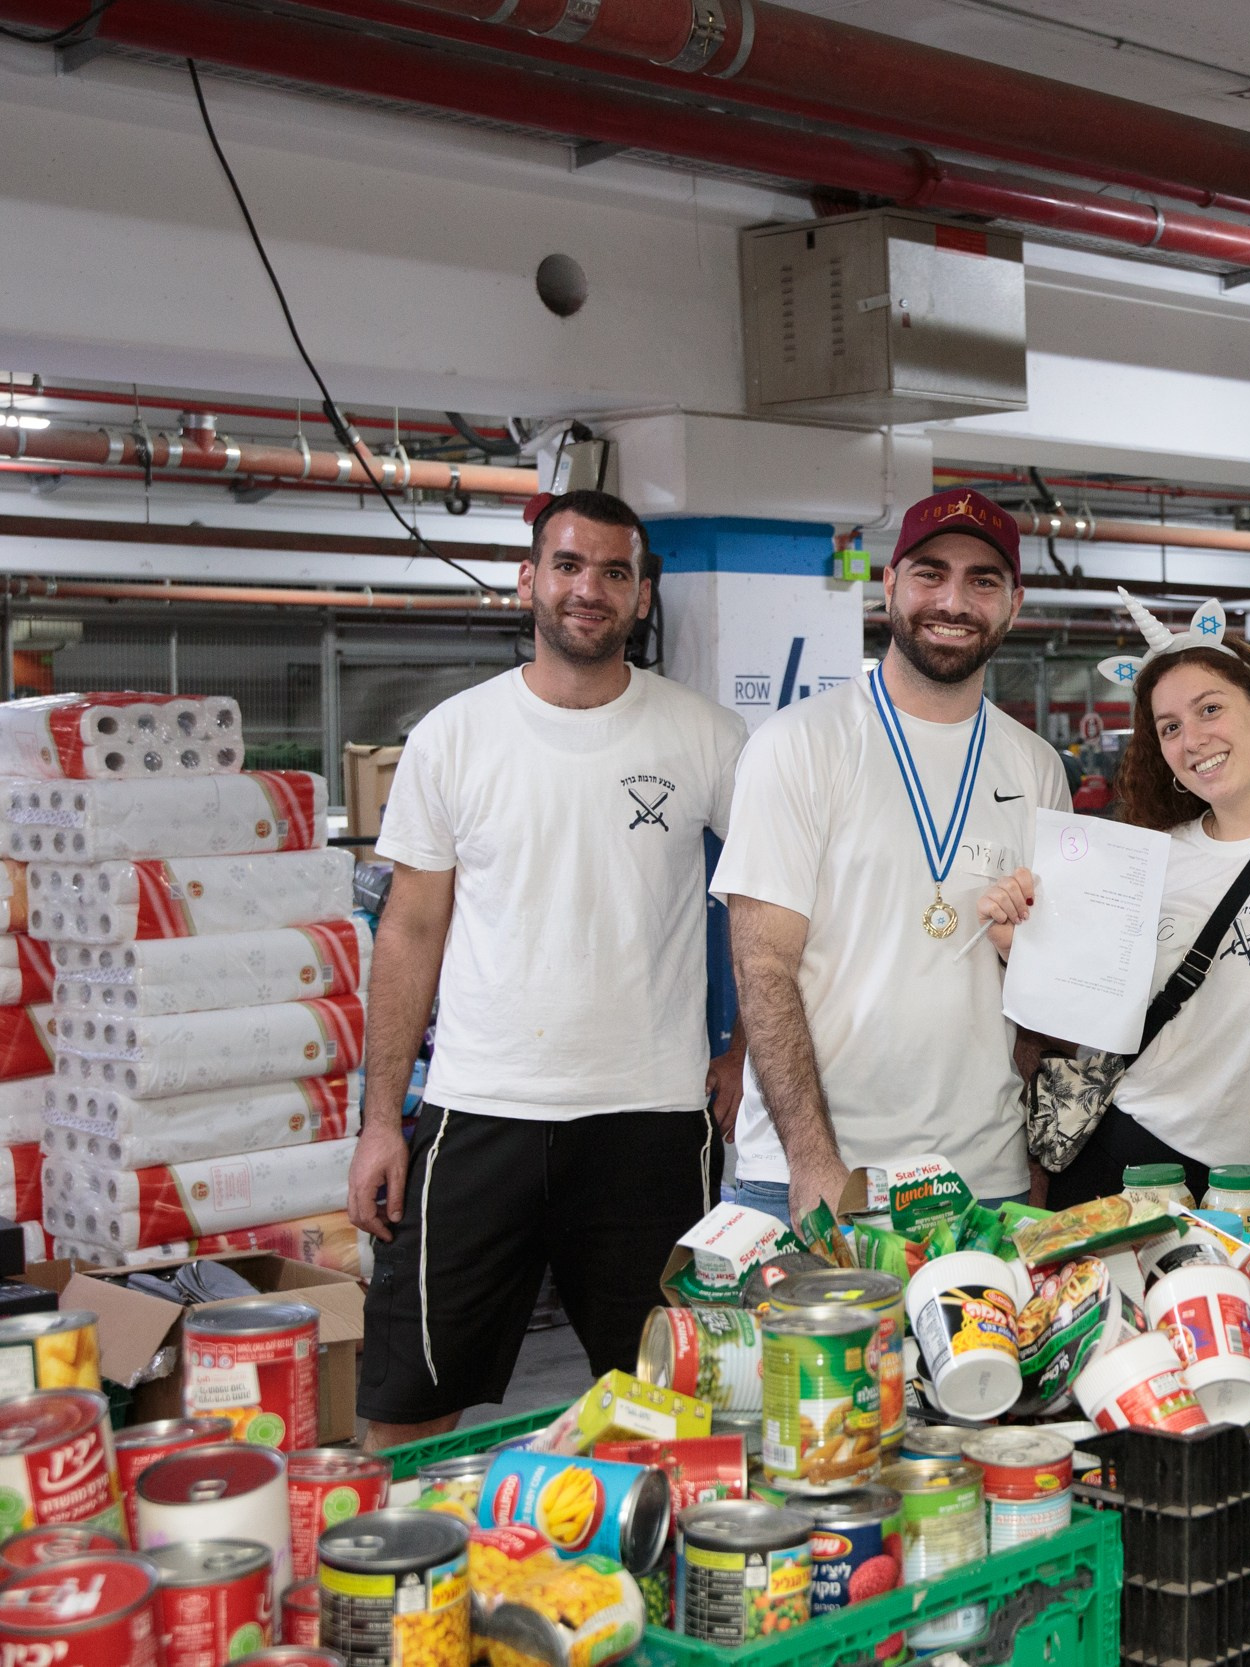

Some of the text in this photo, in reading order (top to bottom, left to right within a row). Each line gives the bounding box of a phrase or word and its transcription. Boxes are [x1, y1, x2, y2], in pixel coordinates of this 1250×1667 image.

[920, 503, 1003, 529] JORDAN
[735, 681, 771, 700] ROW
[620, 774, 676, 792] מבצע חרבות ברזל
[1067, 836, 1079, 854] 3
[895, 1178, 962, 1212] Lunchbox
